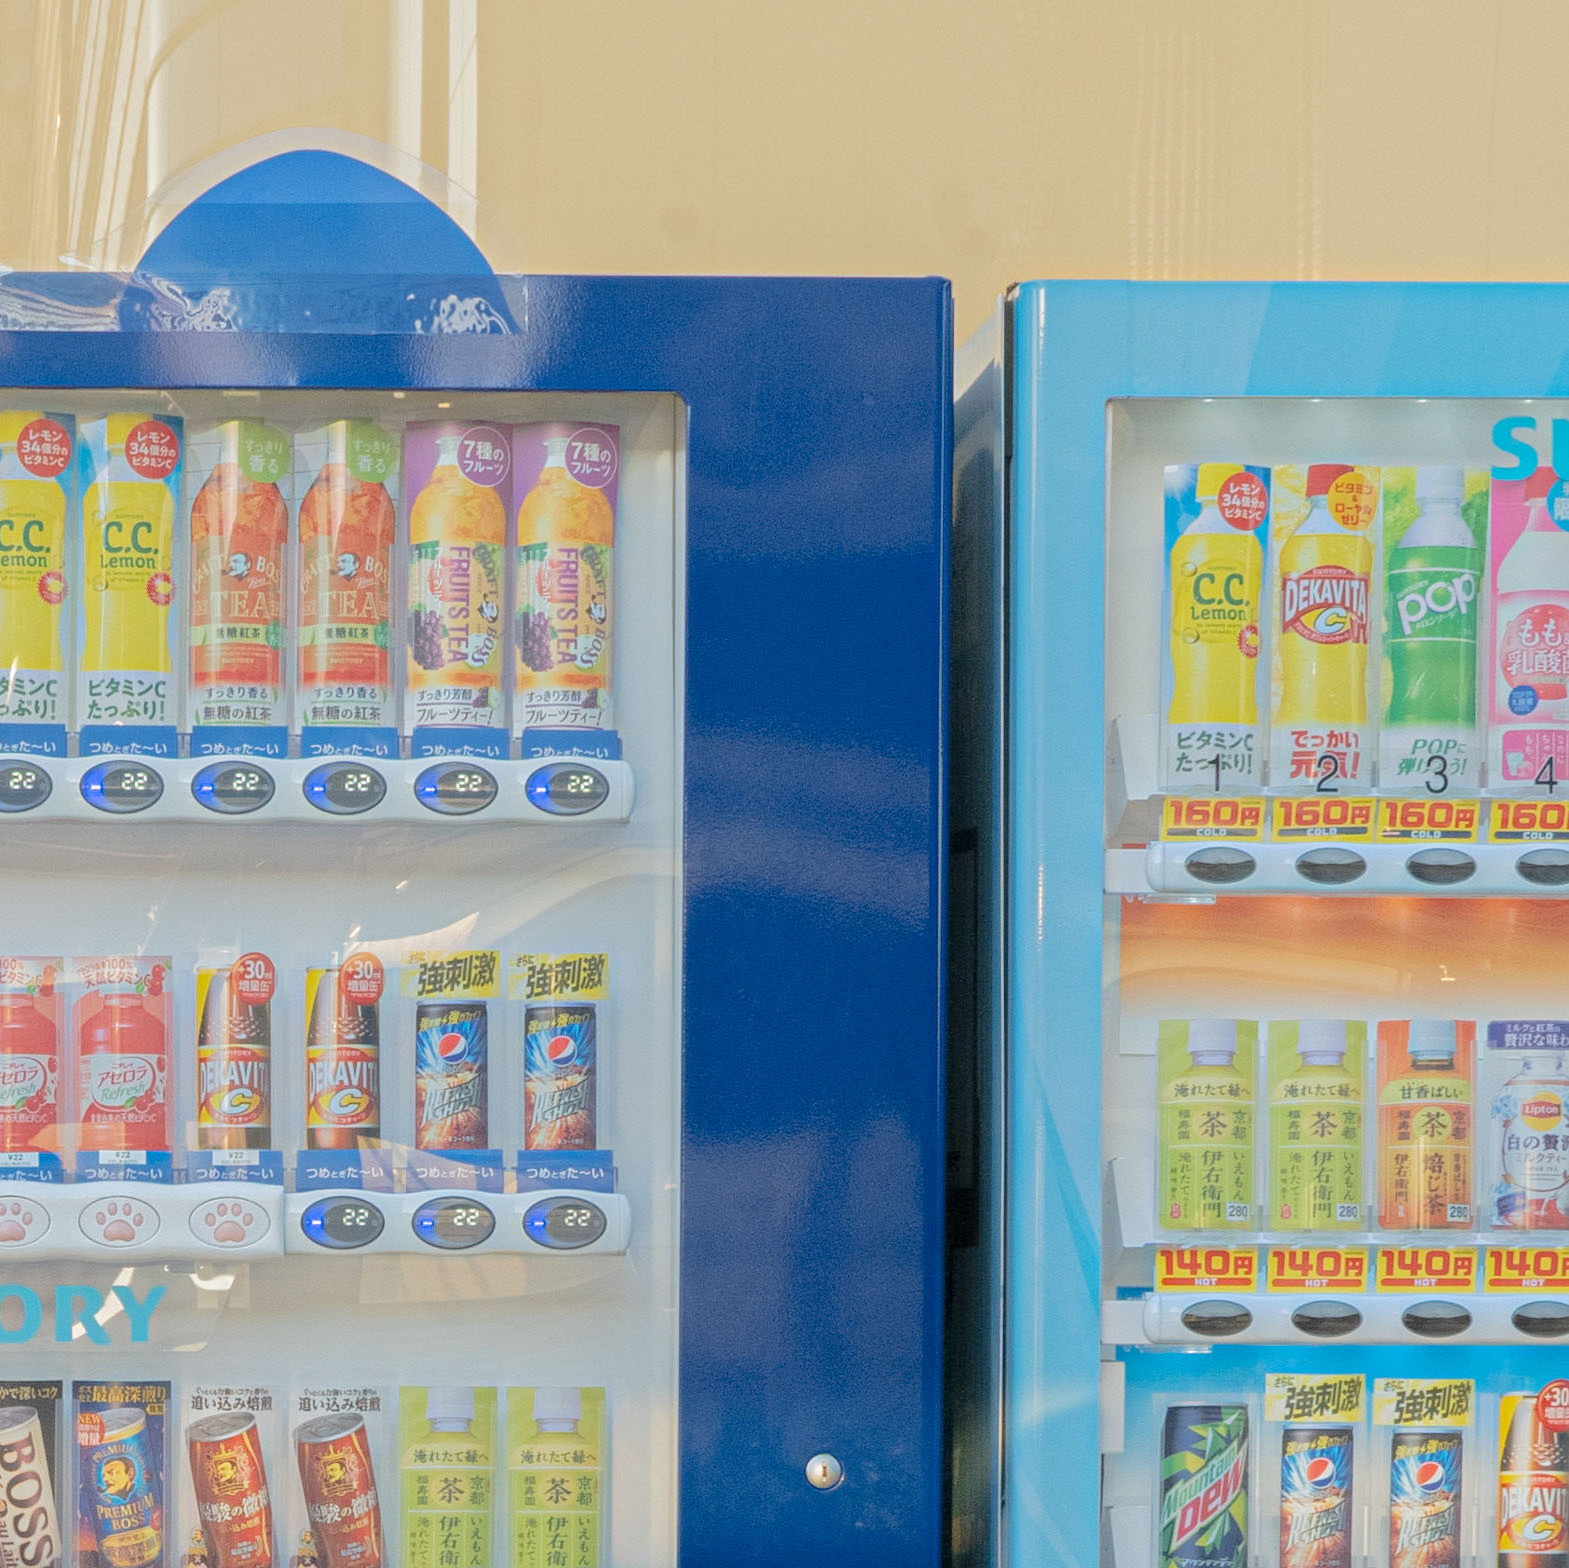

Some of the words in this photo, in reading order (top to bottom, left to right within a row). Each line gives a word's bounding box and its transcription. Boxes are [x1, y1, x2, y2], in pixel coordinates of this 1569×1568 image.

[464, 440, 505, 461] 7種の
[464, 460, 504, 475] フルーツ
[1229, 482, 1261, 494] レモン
[1225, 508, 1261, 520] ビタミンC
[448, 546, 471, 619] FRUITS
[1193, 573, 1250, 606] C.C.
[211, 592, 271, 619] TEA
[1285, 578, 1367, 623] DEKAVITA
[1191, 606, 1246, 621] Lemon
[1314, 607, 1347, 634] C
[448, 625, 470, 663] TEA
[203, 706, 272, 721] 無糖の紅茶
[1177, 731, 1253, 751] ビタミンC
[1291, 730, 1359, 748] でっかい
[9, 772, 35, 789] 22
[233, 774, 259, 790] 22
[1316, 754, 1338, 792] 2
[1426, 755, 1448, 793] 3
[1535, 756, 1558, 794] 4
[1170, 800, 1261, 826] 160円
[1280, 799, 1370, 826] 160円
[1196, 828, 1227, 836] COLD
[526, 955, 606, 999] 強刺激
[1523, 1104, 1559, 1115] Lipton
[1200, 1111, 1227, 1138] 茶
[1232, 1110, 1247, 1140] 京都
[342, 1209, 368, 1225] 22
[1229, 1205, 1248, 1219] 280
[1449, 1205, 1468, 1219] 280
[1161, 1250, 1253, 1276] 140円
[1273, 1251, 1364, 1277] 140円
[1194, 1278, 1217, 1286] HOT
[191, 1395, 273, 1411] 追い込み焙煎
[1285, 1378, 1361, 1421] 強刺激
[97, 1495, 155, 1520] PREMIUM
[112, 1515, 145, 1531] BOSS
